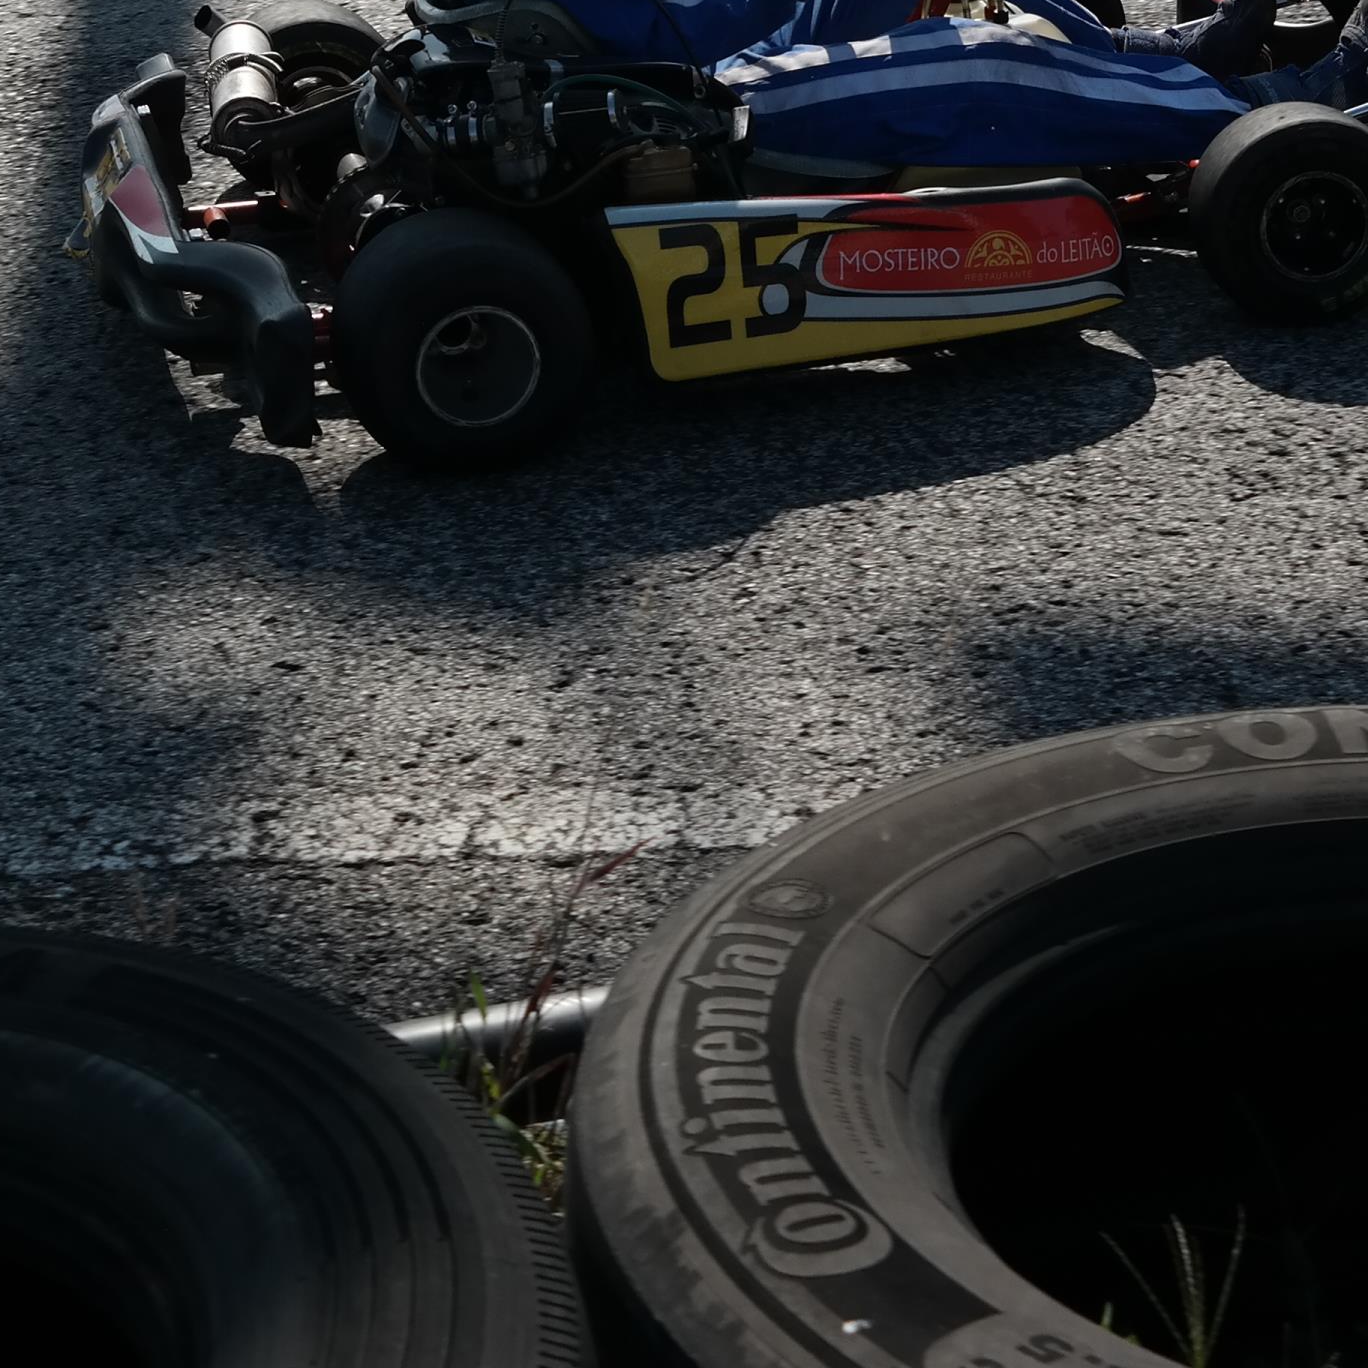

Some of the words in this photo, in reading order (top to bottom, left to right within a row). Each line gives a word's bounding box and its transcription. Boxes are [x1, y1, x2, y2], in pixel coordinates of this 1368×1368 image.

[659, 214, 807, 348] 25
[839, 247, 961, 280] MOSTEIRO
[1036, 241, 1058, 264] do
[1060, 232, 1115, 264] LEITÃO
[964, 269, 1033, 281] RESTAURANTE
[677, 920, 895, 1279] Continental
